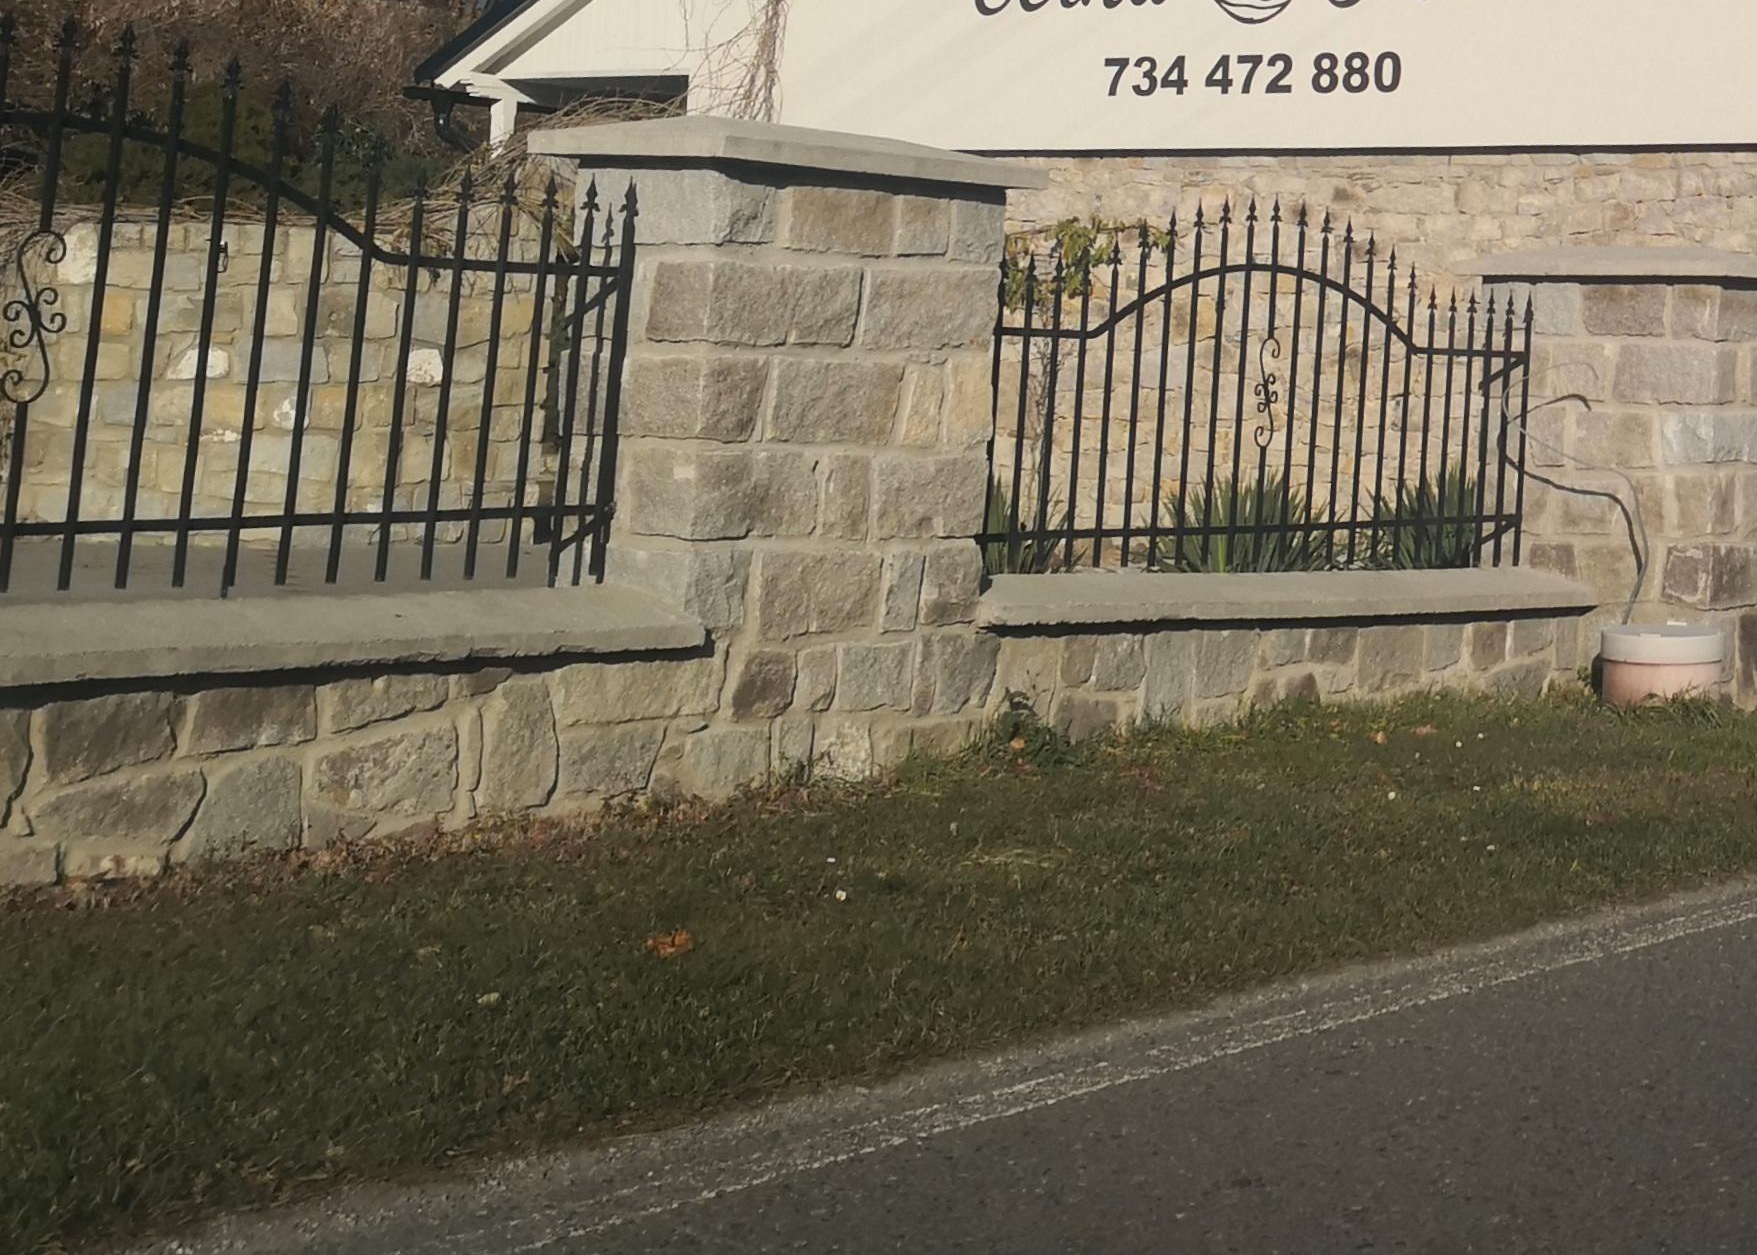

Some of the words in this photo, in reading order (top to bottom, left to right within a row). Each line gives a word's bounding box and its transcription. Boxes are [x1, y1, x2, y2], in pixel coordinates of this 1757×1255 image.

[1104, 56, 1189, 97] 734
[1204, 54, 1293, 95] 472
[1311, 51, 1402, 94] 880
